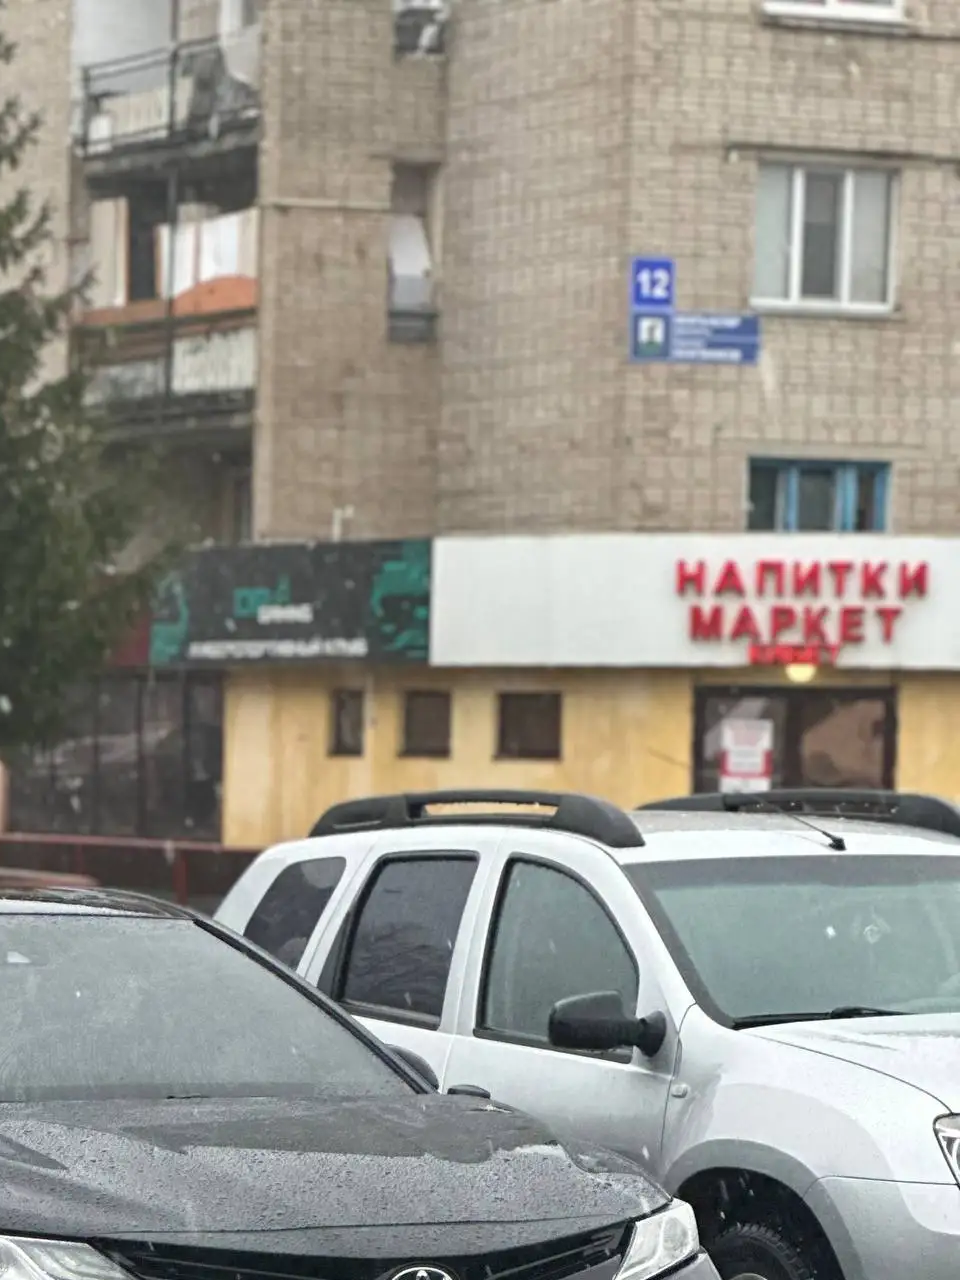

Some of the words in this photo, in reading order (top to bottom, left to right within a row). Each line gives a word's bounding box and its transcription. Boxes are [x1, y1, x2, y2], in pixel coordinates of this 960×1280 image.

[636, 268, 670, 300] 12
[674, 559, 930, 598] НАПИТКИ
[689, 604, 904, 644] МАРКЕТ
